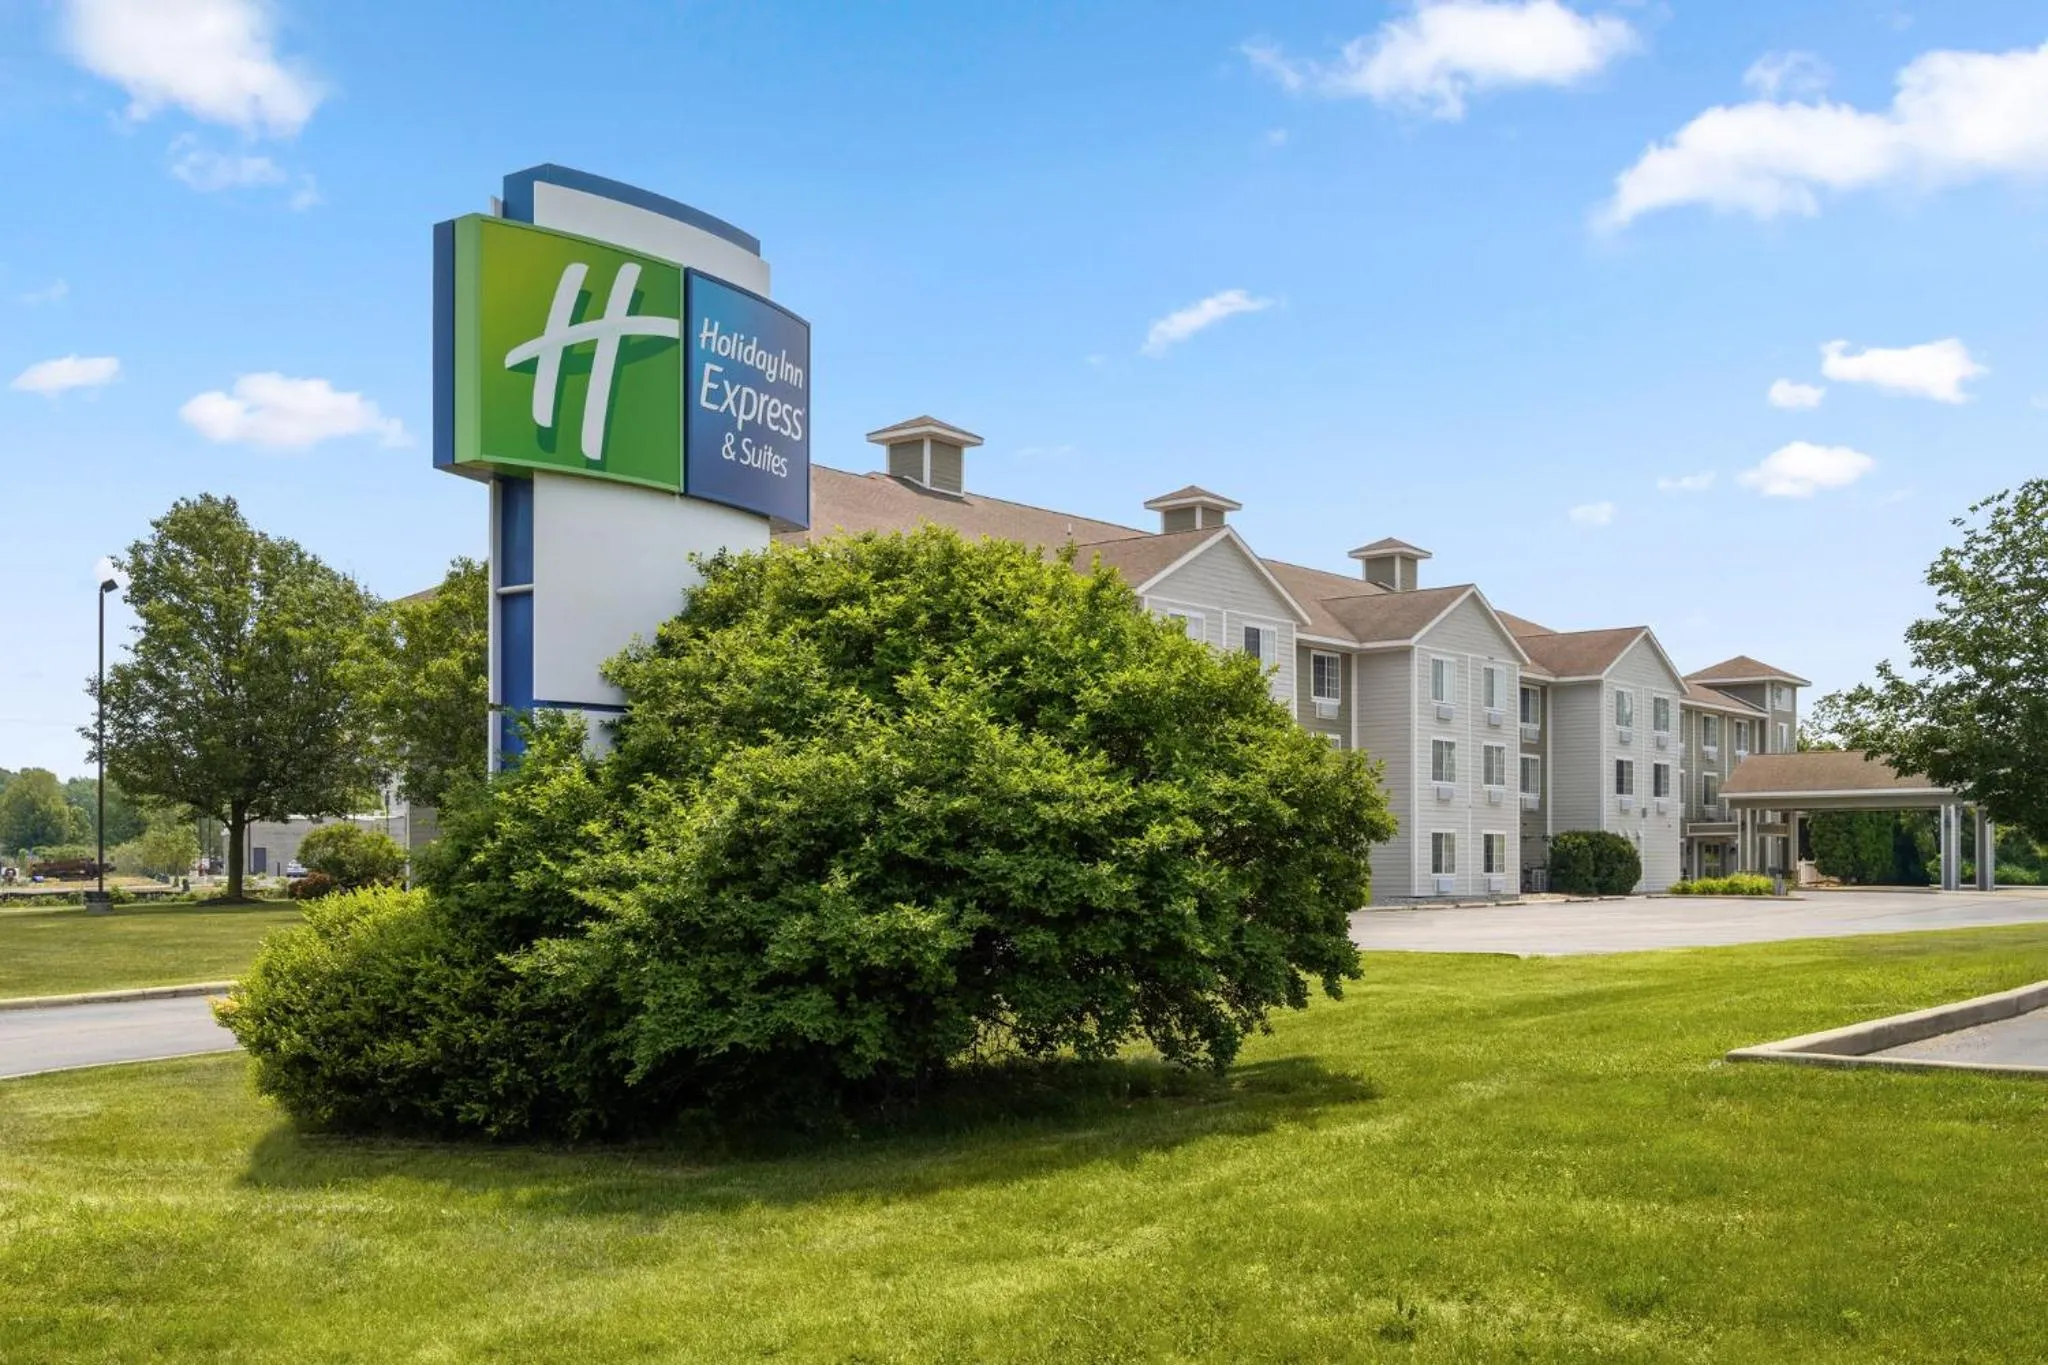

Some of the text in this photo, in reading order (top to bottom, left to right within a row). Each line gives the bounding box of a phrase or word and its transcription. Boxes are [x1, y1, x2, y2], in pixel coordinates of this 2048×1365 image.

[699, 317, 803, 388] Holiday Inn
[700, 362, 803, 440] Express
[722, 432, 788, 478] & Suites
